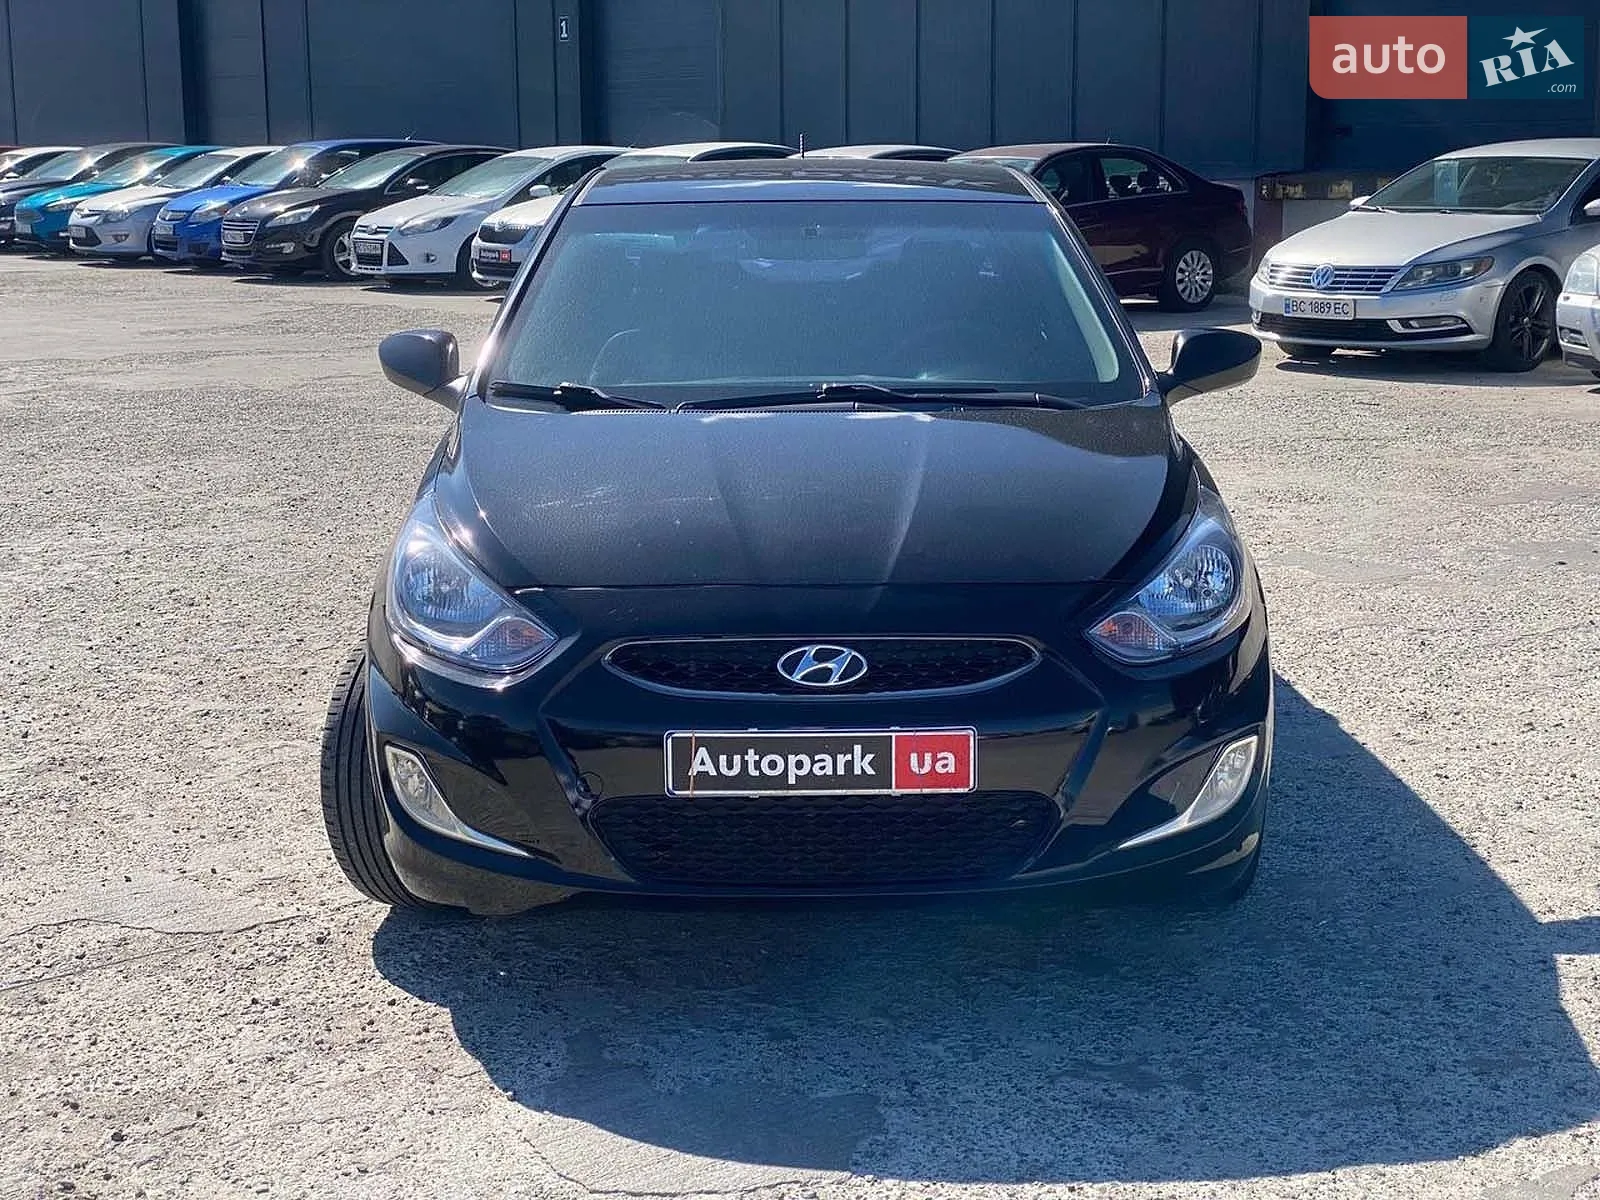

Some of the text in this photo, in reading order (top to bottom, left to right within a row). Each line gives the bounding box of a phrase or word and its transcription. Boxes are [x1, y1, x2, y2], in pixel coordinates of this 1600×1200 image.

[560, 20, 568, 38] 1
[1291, 300, 1306, 313] BC
[1308, 300, 1332, 314] 1889
[1334, 302, 1350, 315] EC
[687, 744, 957, 785] Autopark ua
